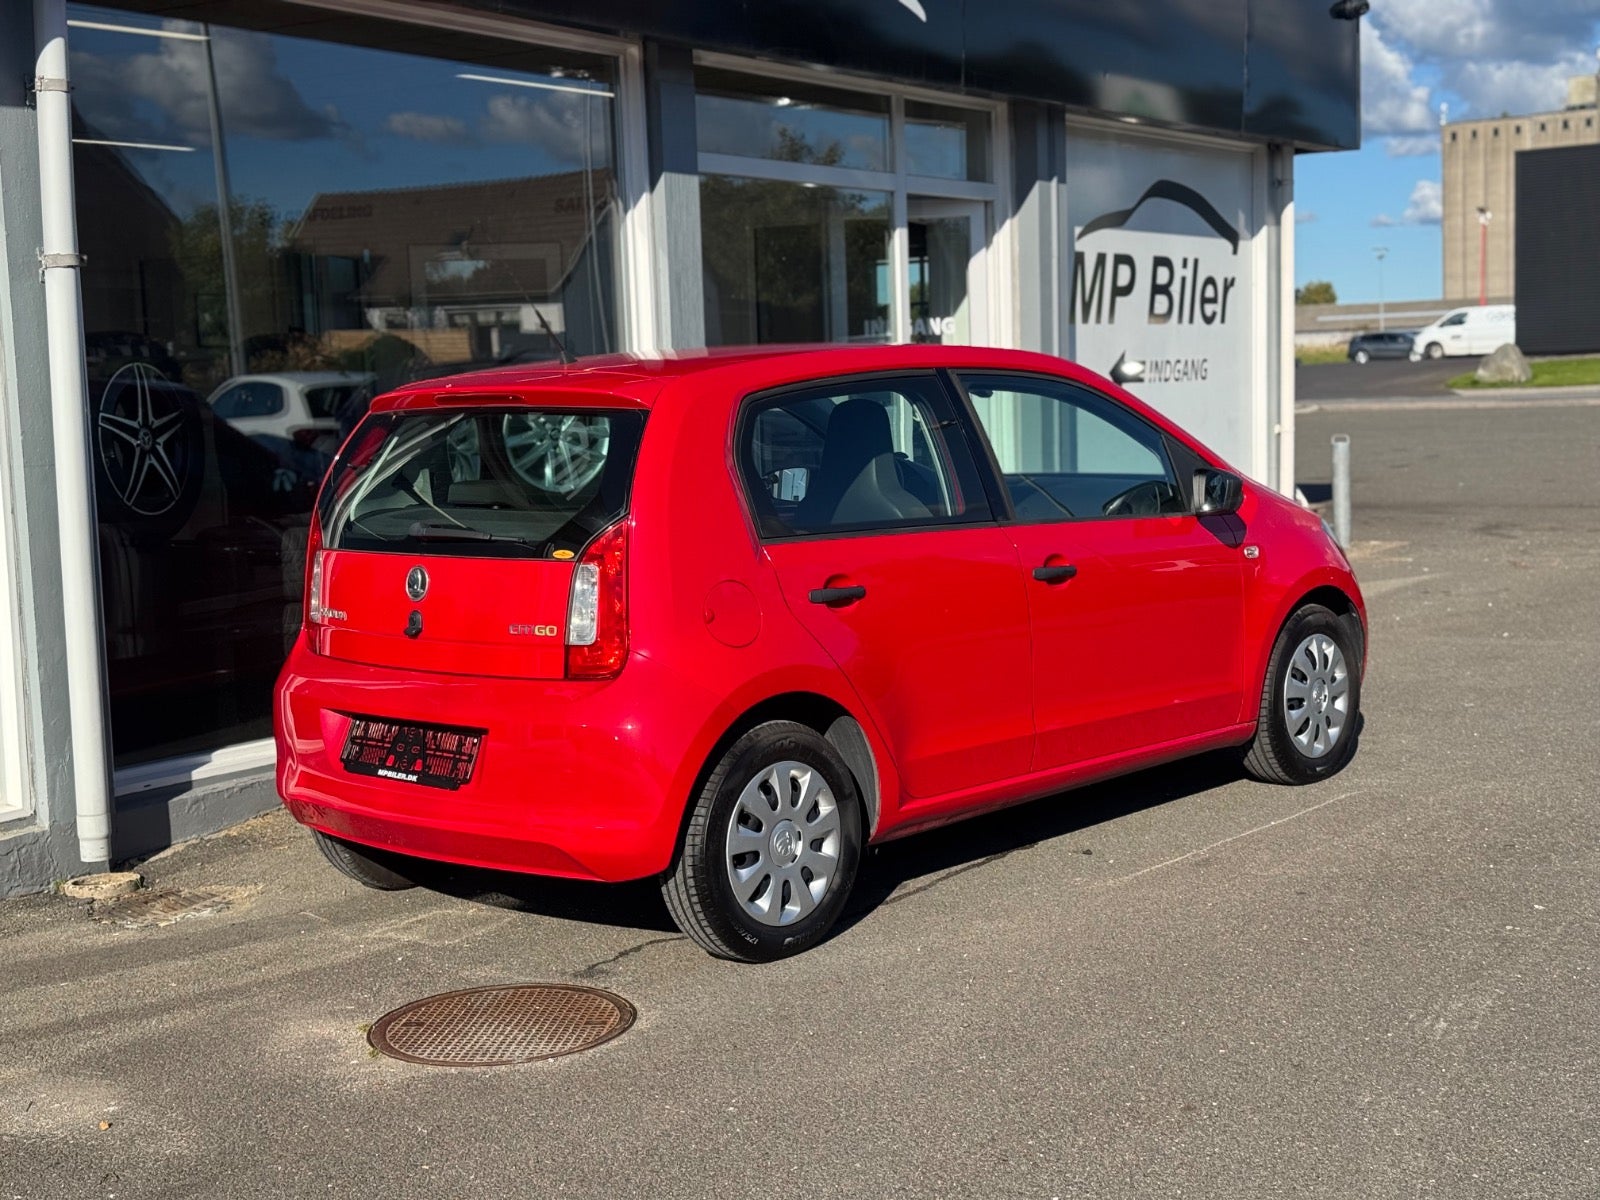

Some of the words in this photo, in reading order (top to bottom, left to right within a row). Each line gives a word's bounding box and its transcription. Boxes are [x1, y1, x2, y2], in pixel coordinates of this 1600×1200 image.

[1068, 251, 1137, 325] MP
[1147, 255, 1236, 326] Biler
[1148, 358, 1208, 384] INDGANG
[377, 768, 419, 783] MPBILER.DK
